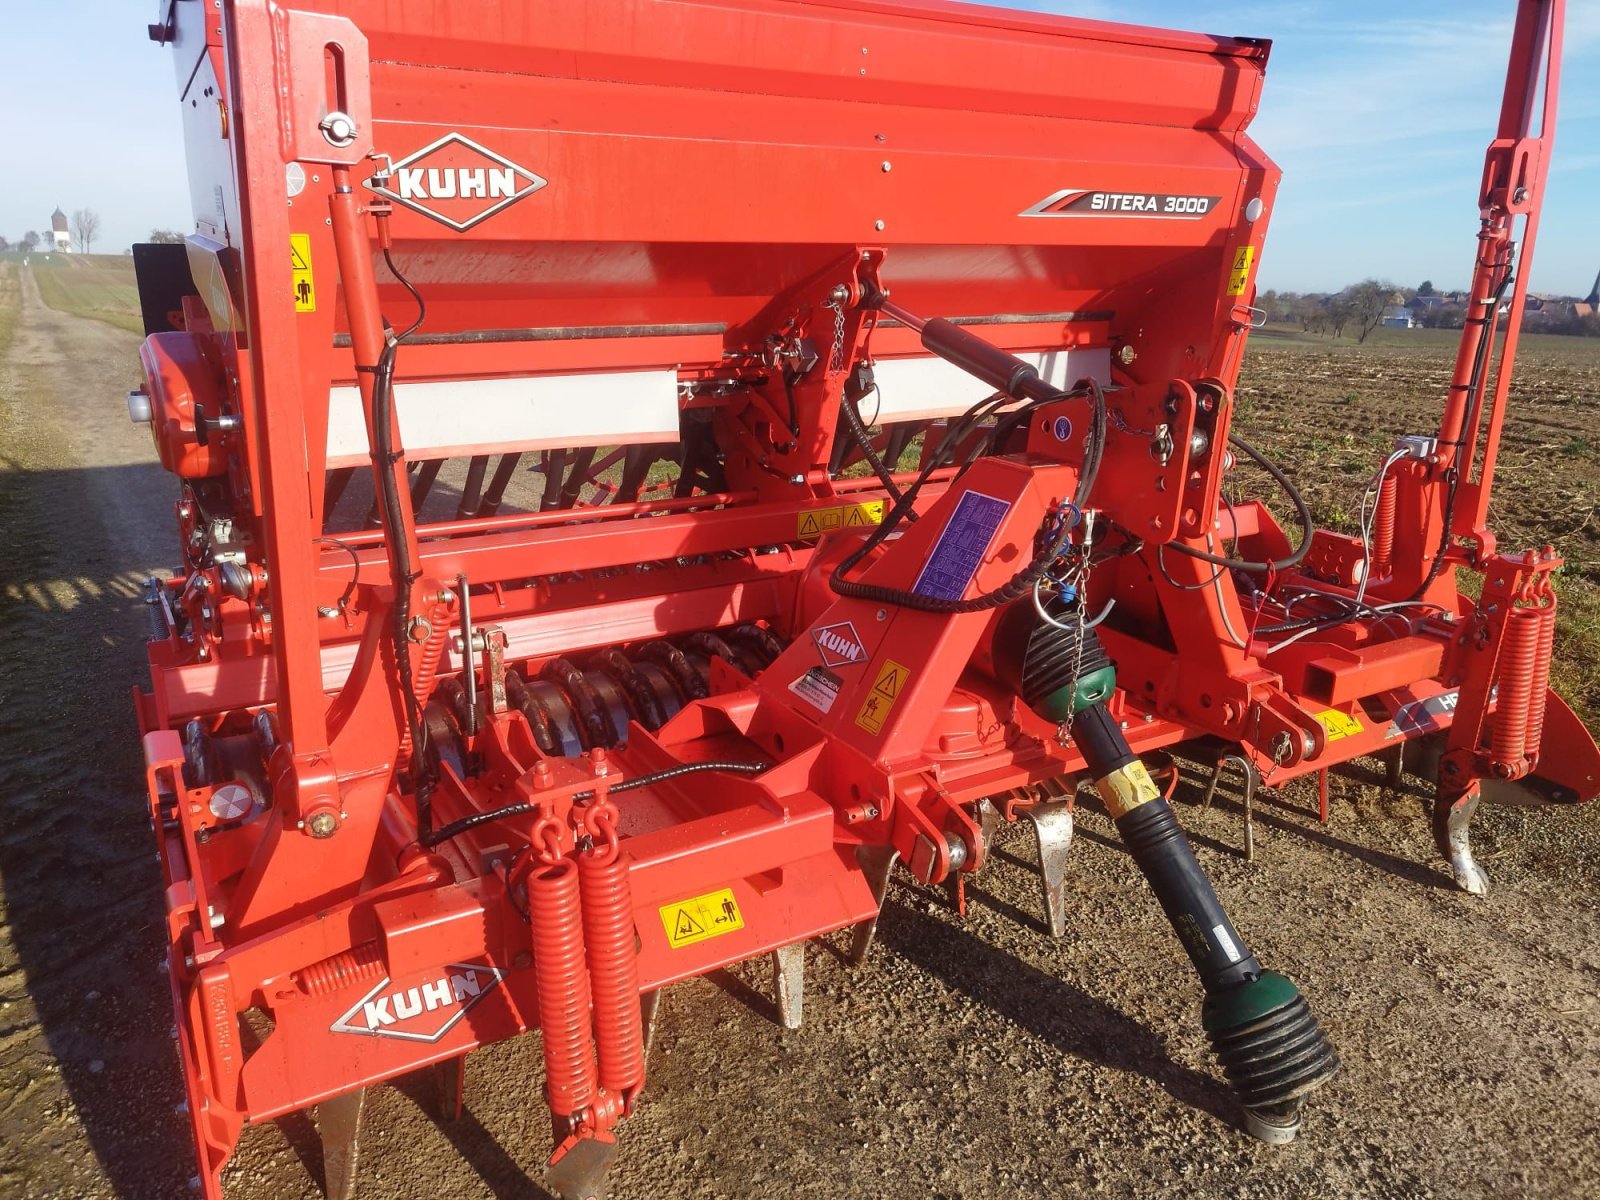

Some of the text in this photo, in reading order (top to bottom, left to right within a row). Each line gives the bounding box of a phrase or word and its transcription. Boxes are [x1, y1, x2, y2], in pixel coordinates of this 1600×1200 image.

[398, 168, 516, 198] KUHN
[1091, 194, 1209, 213] SITERA 3000
[818, 629, 861, 661] KUHN
[363, 969, 481, 1031] KUHN
